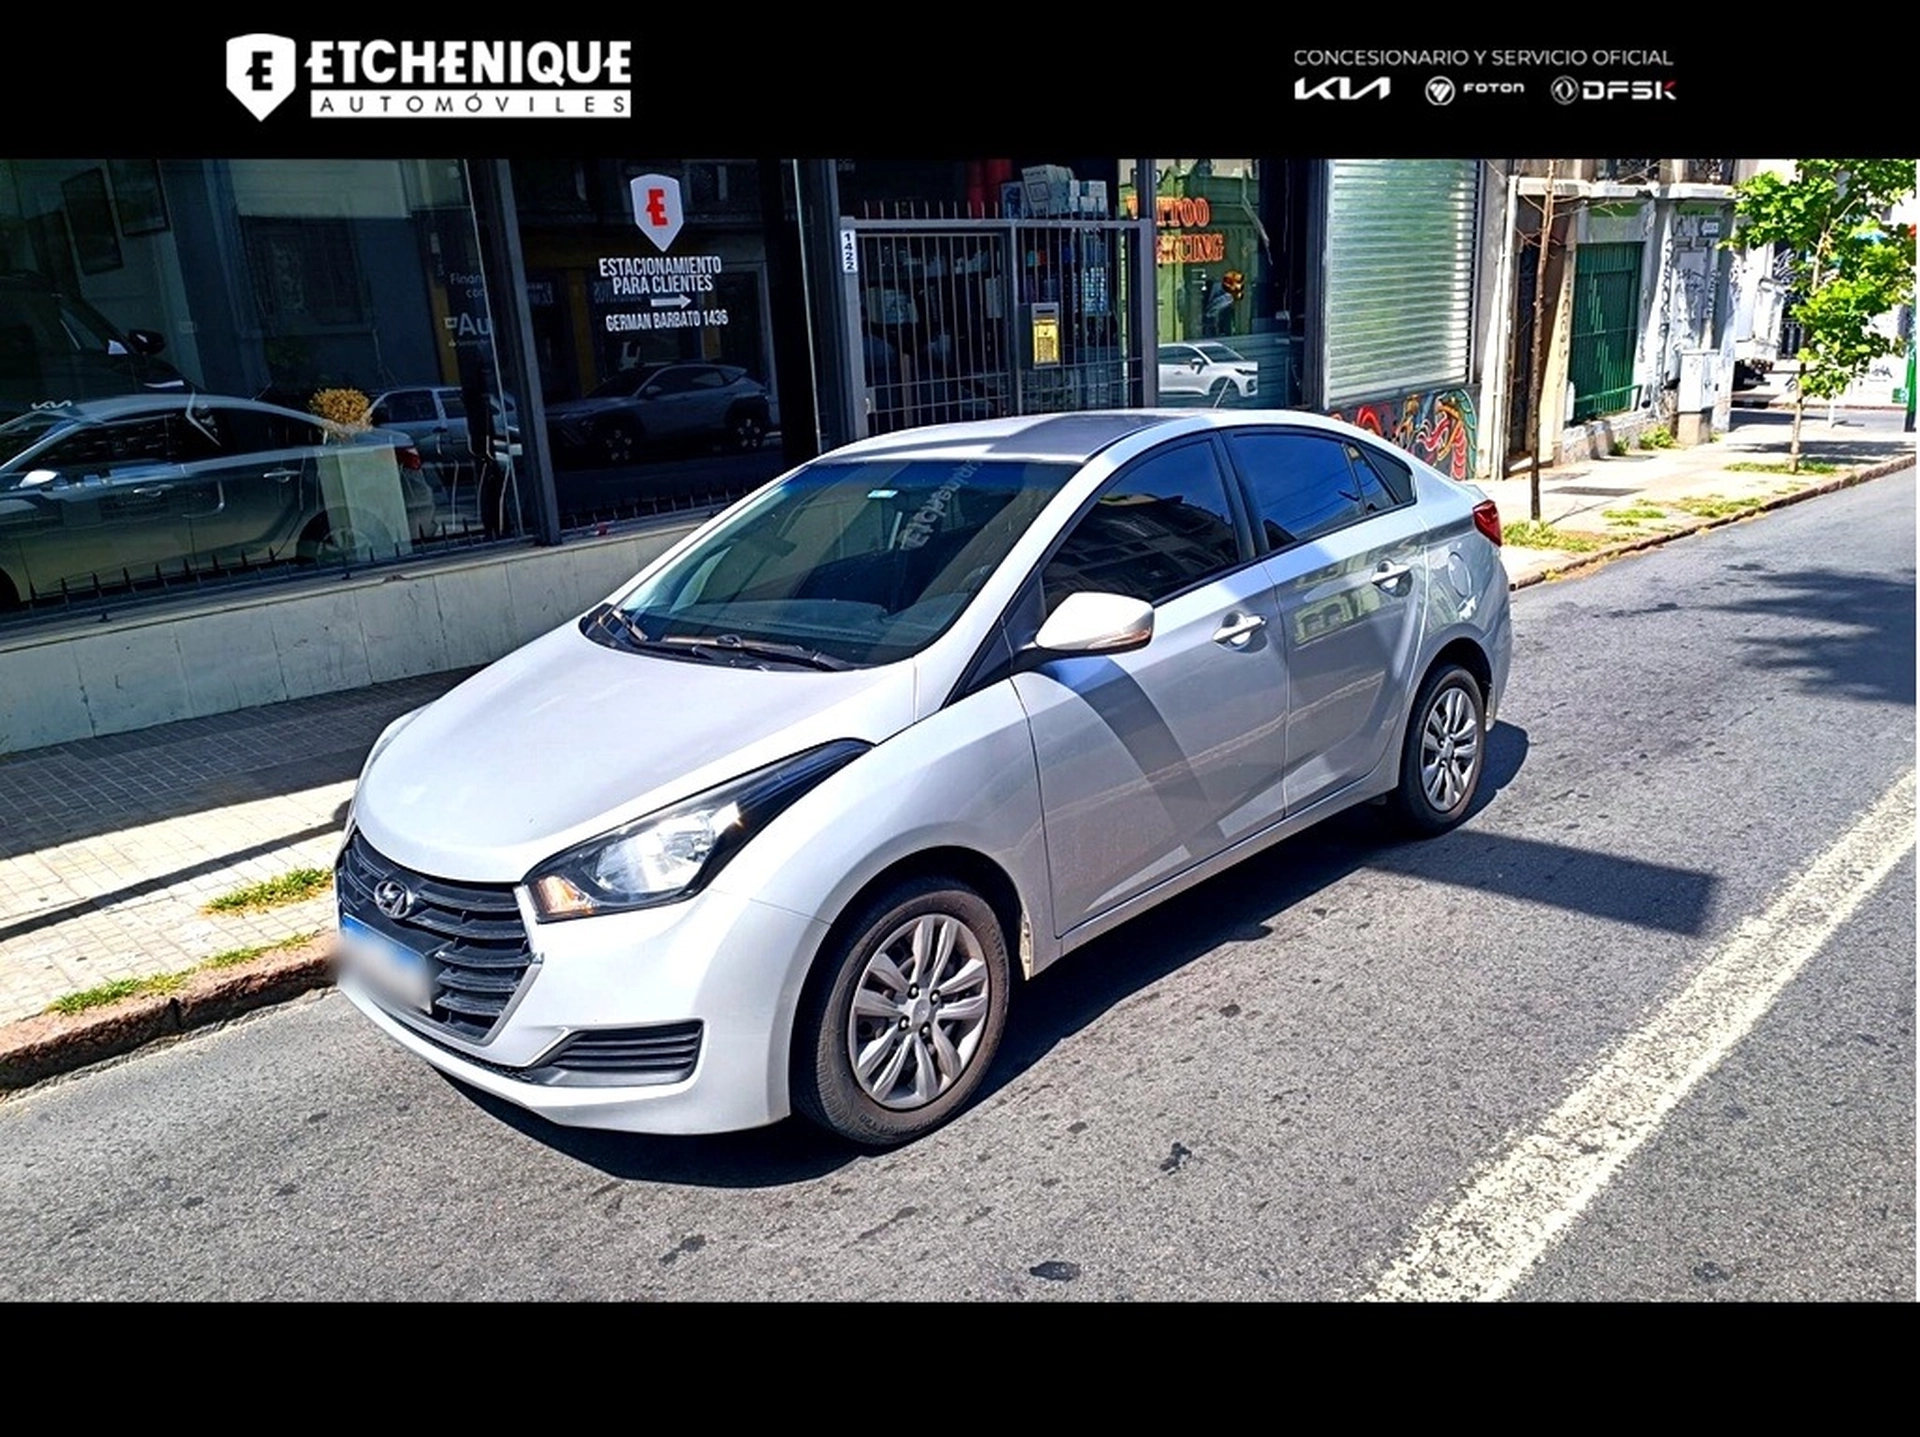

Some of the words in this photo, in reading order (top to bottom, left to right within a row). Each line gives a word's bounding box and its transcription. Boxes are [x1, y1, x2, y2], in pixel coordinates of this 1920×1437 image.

[1126, 195, 1210, 228] TTTOO
[844, 232, 854, 269] 1422
[598, 256, 722, 277] ESTACIONAMIENTO
[612, 276, 651, 295] PARA
[651, 274, 715, 293] CLIENTES
[605, 312, 653, 332] GERMAN
[652, 309, 702, 329] BARBATO
